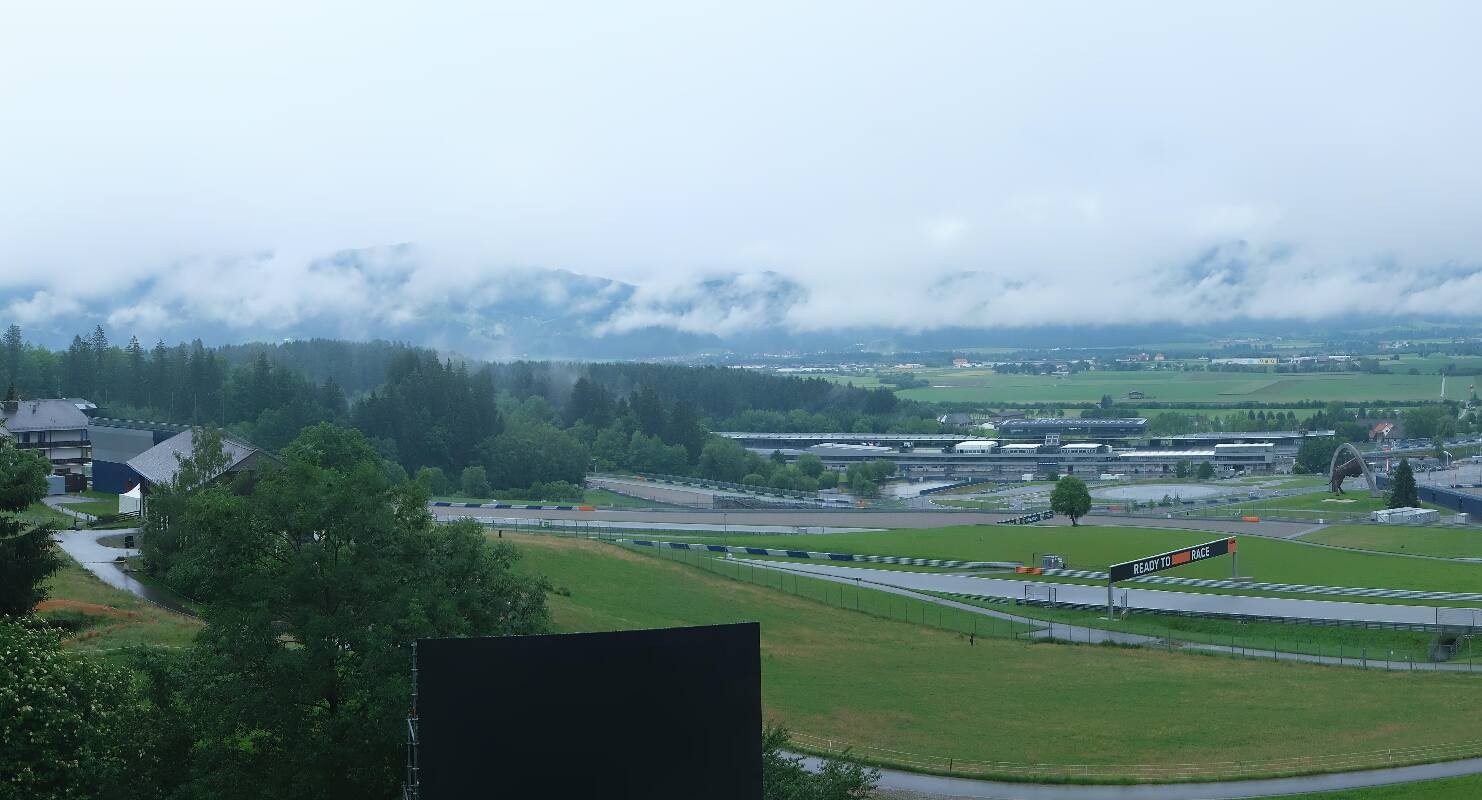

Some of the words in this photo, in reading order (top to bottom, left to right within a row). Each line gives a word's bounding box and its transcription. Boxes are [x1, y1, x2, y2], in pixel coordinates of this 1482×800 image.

[1133, 558, 1159, 575] READY
[1160, 556, 1171, 568] TO
[1191, 546, 1210, 561] RACE
